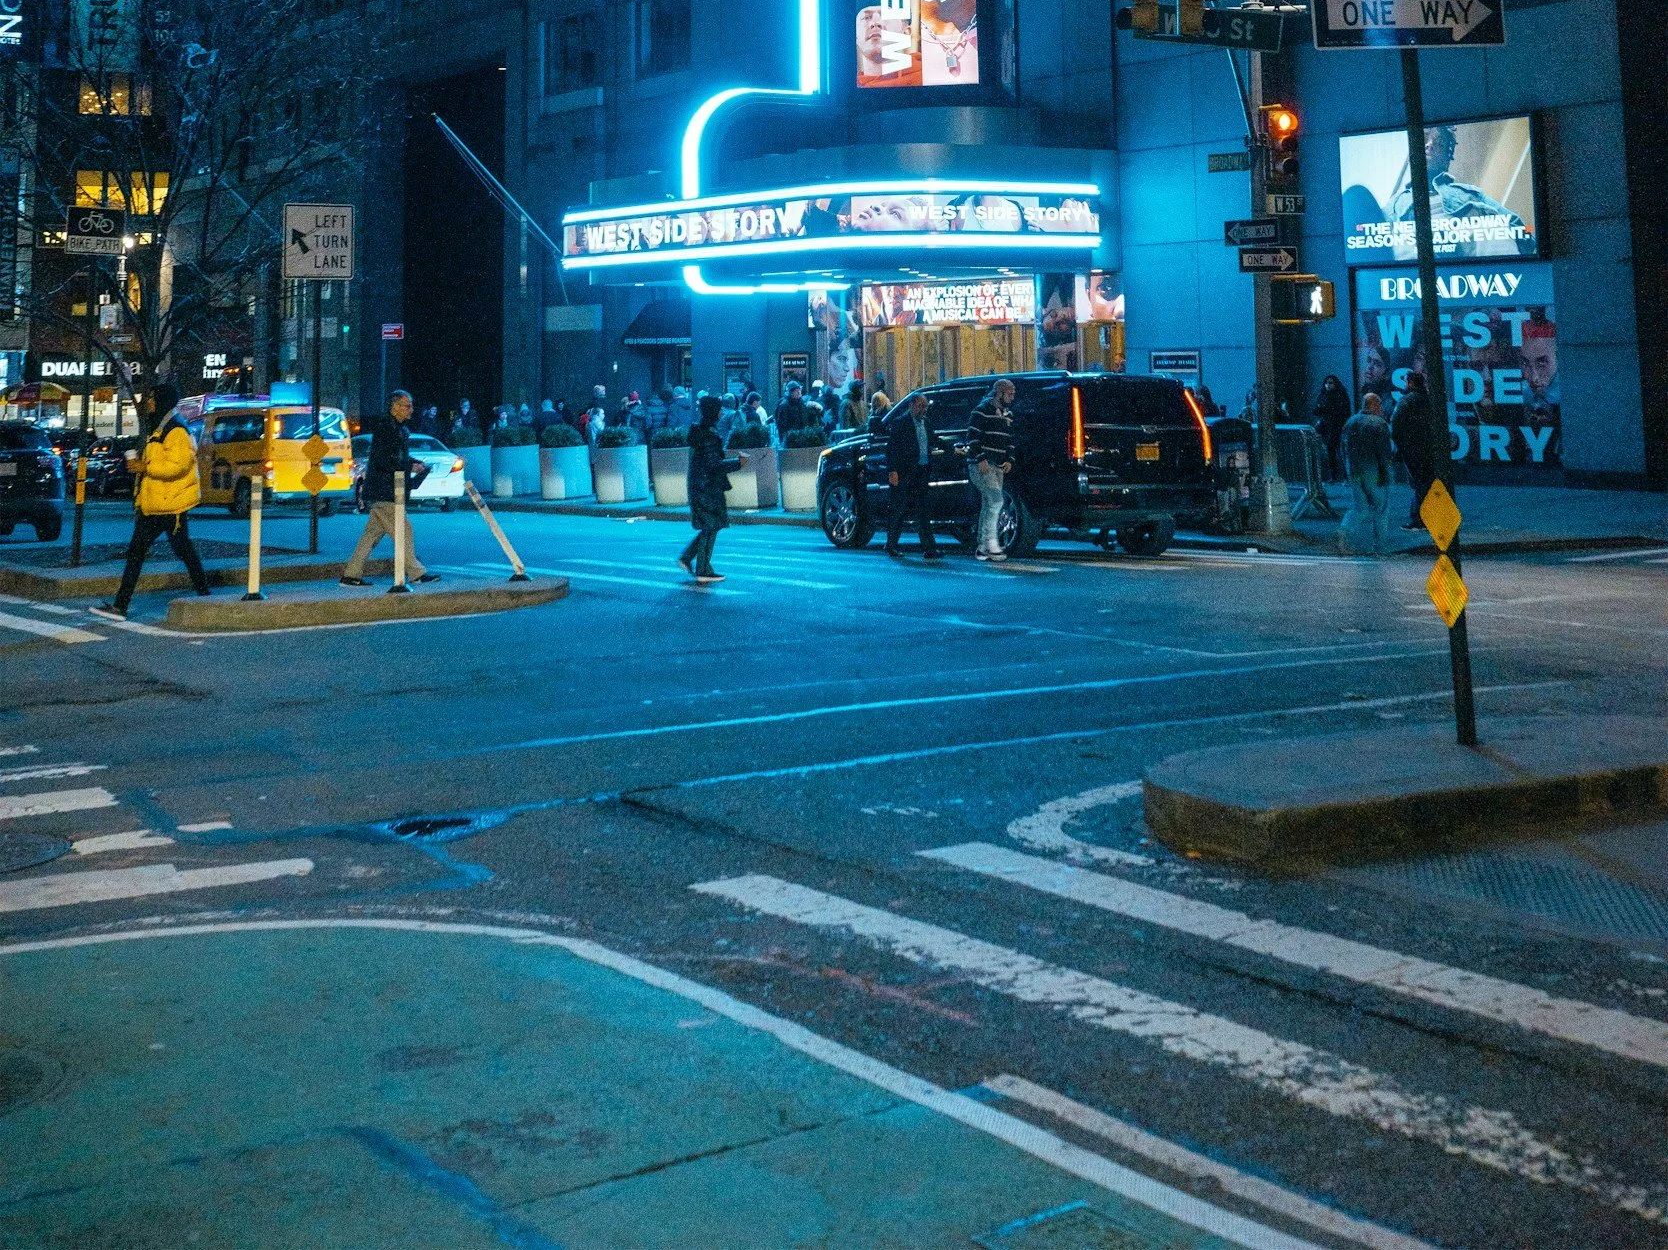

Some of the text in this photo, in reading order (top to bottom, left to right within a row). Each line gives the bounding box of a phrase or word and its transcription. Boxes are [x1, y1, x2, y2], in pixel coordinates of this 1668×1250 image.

[1342, 0, 1474, 26] ONE WAY
[1230, 18, 1255, 41] St
[1276, 198, 1283, 212] W
[1285, 197, 1295, 212] 53
[315, 215, 346, 228] LEFT
[908, 205, 1081, 222] WEST SIDE STORY
[587, 208, 797, 251] WEST SIDE STORY
[1233, 224, 1271, 238] ONE WAY
[1393, 220, 1416, 234] NE
[1431, 214, 1512, 231] BROADWAY
[70, 236, 119, 252] BIKE PATH
[314, 235, 348, 248] TURN
[1347, 233, 1416, 249] SEASON'S
[1432, 230, 1471, 245] AJOR
[314, 255, 347, 268] LANE
[1247, 254, 1288, 265] ONE WAY
[923, 284, 981, 298] EXPLOSION
[982, 284, 999, 297] OF
[903, 294, 1034, 312] IMAGINABLE IDEA OF WHA
[932, 309, 979, 323] MUSICAL
[980, 307, 1002, 321] CAN
[1377, 312, 1531, 348] WEST
[1391, 368, 1524, 404] SDE
[1449, 424, 1554, 462] ORY
